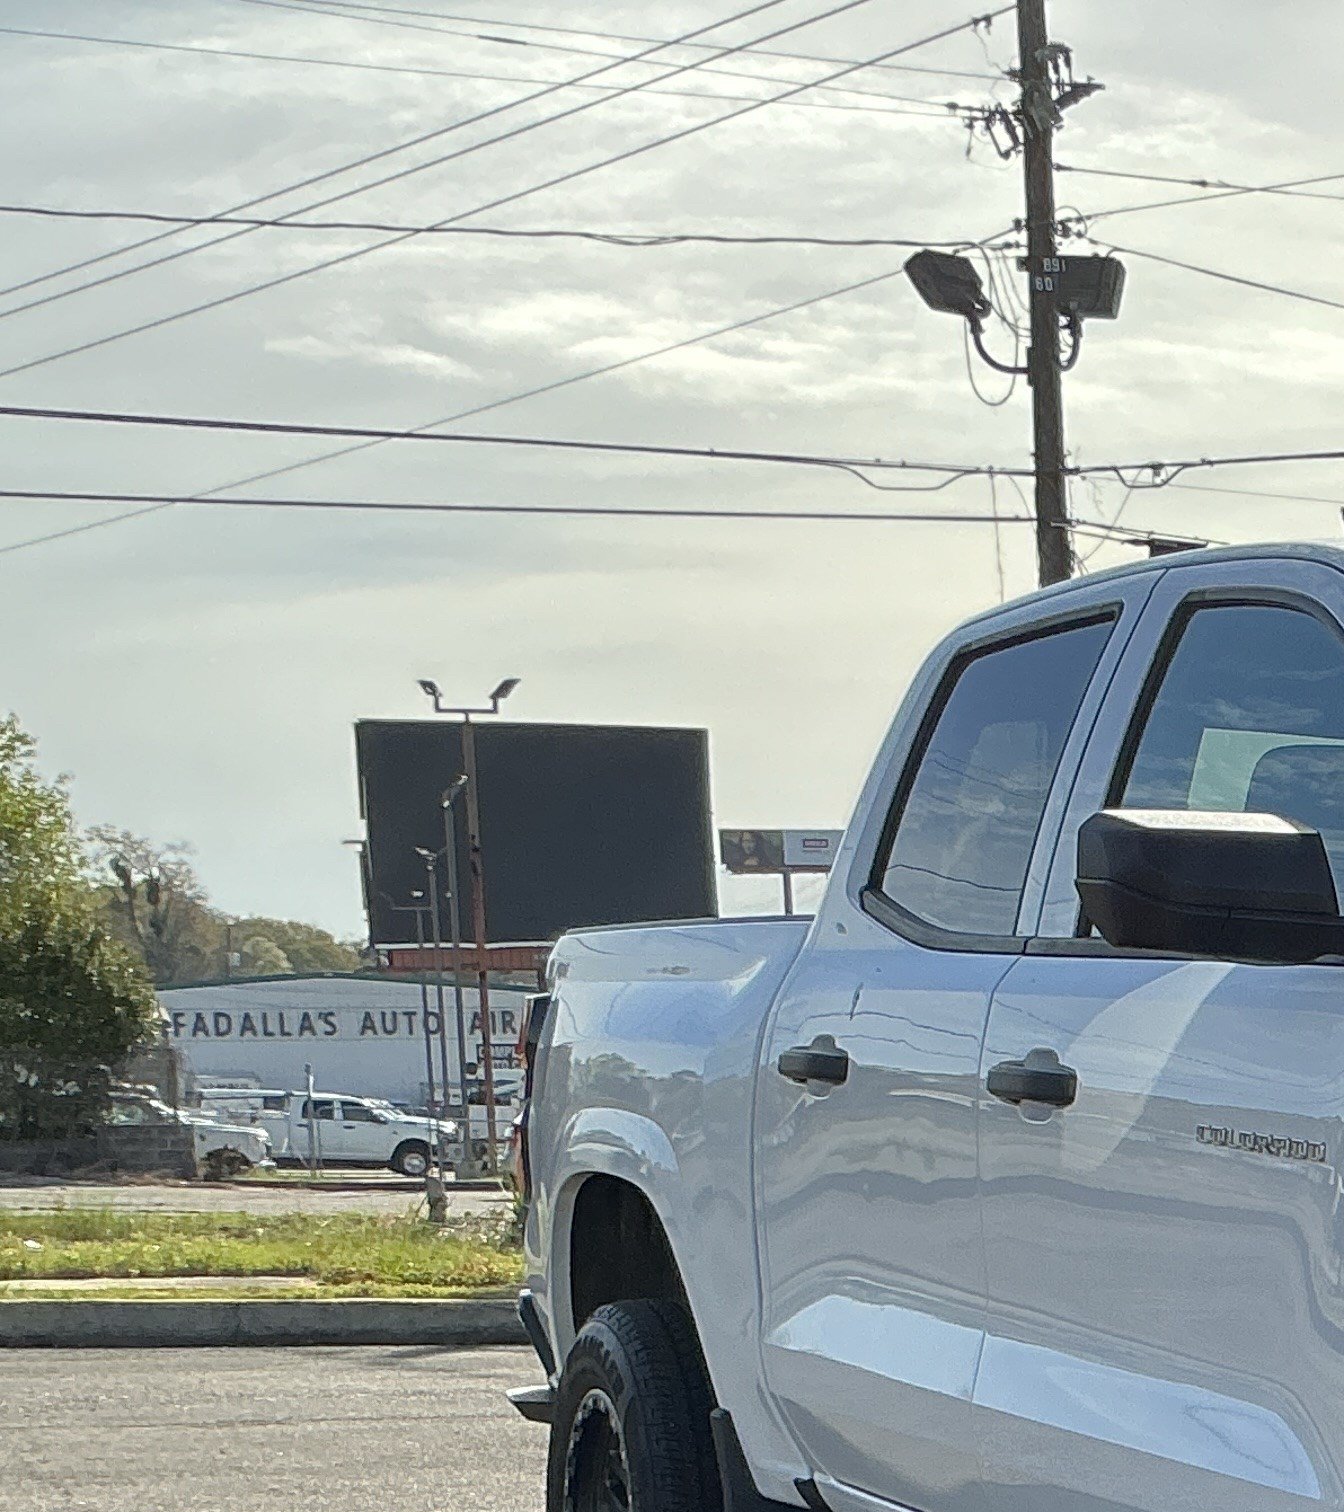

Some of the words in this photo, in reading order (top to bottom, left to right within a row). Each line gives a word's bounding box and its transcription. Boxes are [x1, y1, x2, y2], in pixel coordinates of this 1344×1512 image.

[171, 1011, 338, 1038] FADALLA'S
[359, 1010, 441, 1036] AUTO
[468, 1010, 517, 1035] AIR
